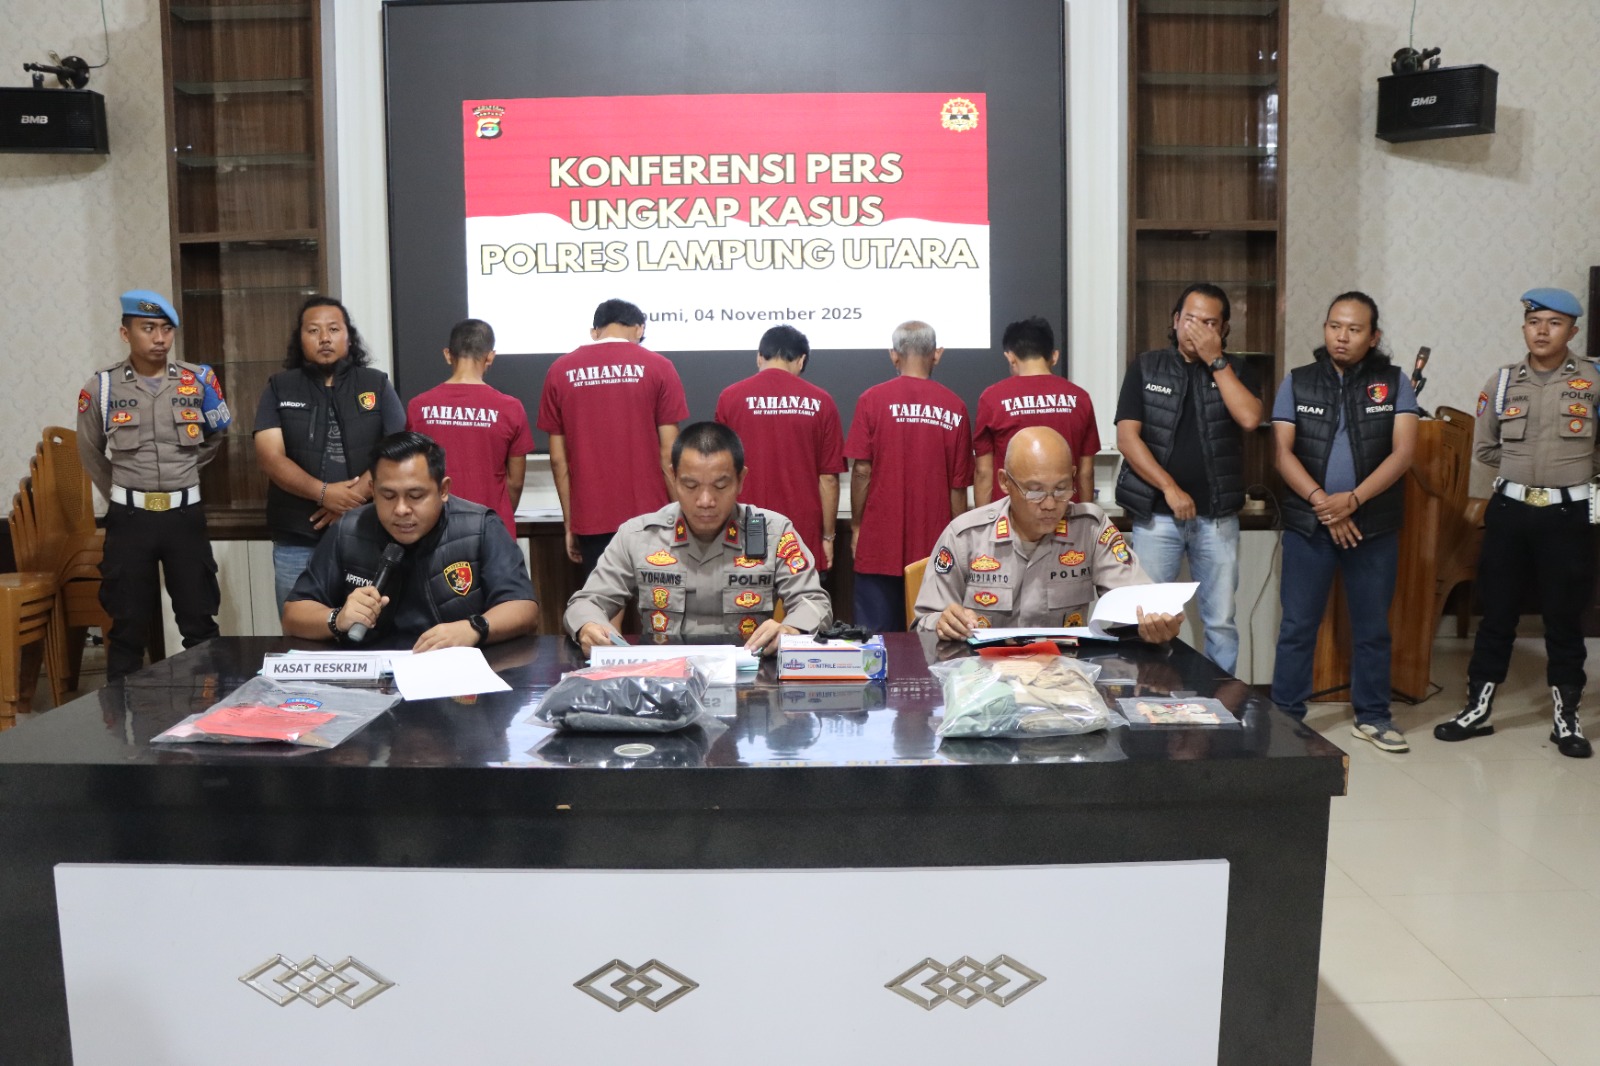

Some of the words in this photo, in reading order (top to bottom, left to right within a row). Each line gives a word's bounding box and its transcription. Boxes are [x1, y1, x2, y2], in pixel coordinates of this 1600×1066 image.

[1410, 95, 1438, 107] BMB
[20, 115, 49, 124] BMB
[549, 153, 796, 188] KONFERENSI
[806, 152, 904, 184] PERS
[570, 196, 740, 231] UNGKAP
[749, 195, 885, 227] KASUS
[481, 240, 629, 275] POLRES
[637, 238, 835, 271] LAMPUNG
[843, 238, 980, 269] UTARA
[694, 308, 715, 322] 04
[720, 306, 816, 321] November
[821, 307, 863, 320] 2025
[566, 364, 645, 383] TAHANAN
[1145, 383, 1172, 395] ADISAR
[1561, 390, 1594, 401] POLRI
[745, 396, 822, 412] TAHANAN
[1001, 394, 1077, 411] TAHANAN
[1365, 404, 1394, 414] RESMOB
[421, 405, 499, 423] TAHANAN
[889, 403, 963, 427] TAHANAN
[1297, 405, 1324, 415] RIAN
[729, 574, 772, 586] POLRI
[1050, 567, 1092, 580] POLRI
[273, 664, 311, 673] KASAT
[313, 663, 368, 673] RESKRIM
